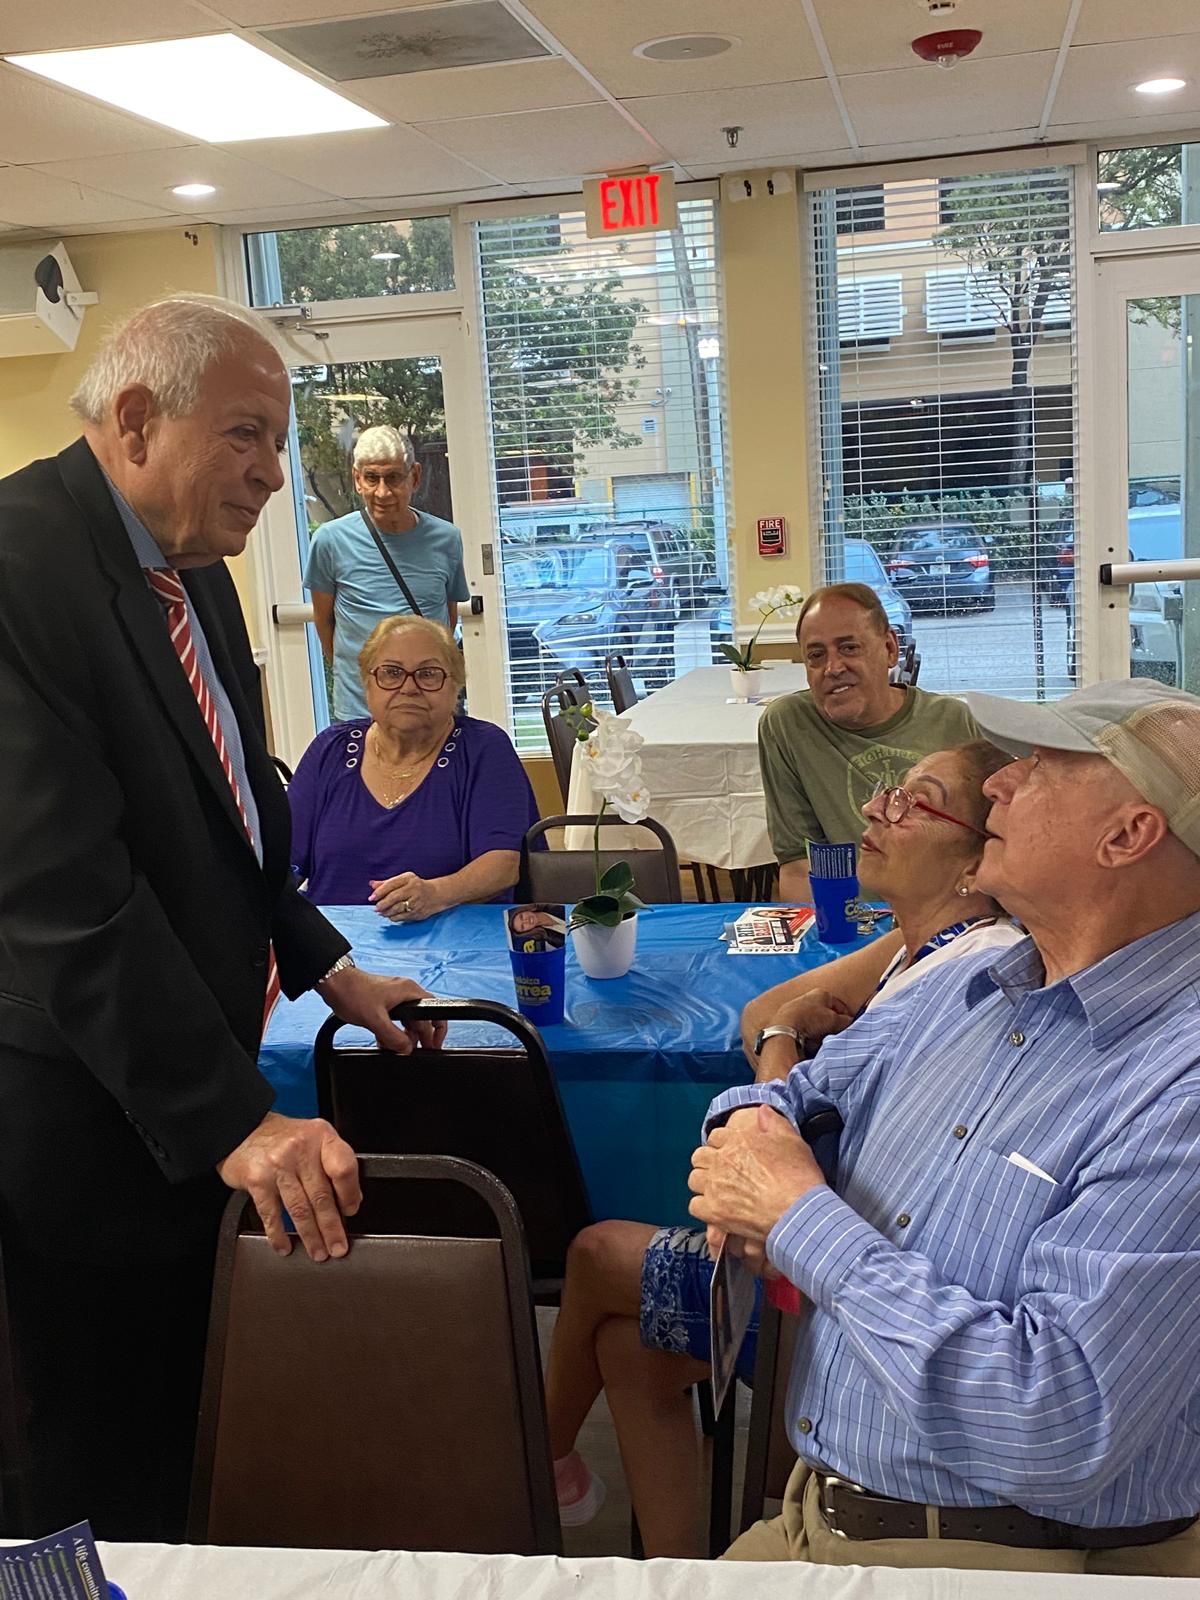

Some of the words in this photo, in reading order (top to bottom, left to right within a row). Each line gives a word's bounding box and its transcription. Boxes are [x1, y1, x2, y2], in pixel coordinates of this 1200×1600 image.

[600, 175, 660, 230] EXIT
[760, 520, 780, 529] FIRE
[72, 1537, 83, 1546] A
[75, 1545, 88, 1561] life
